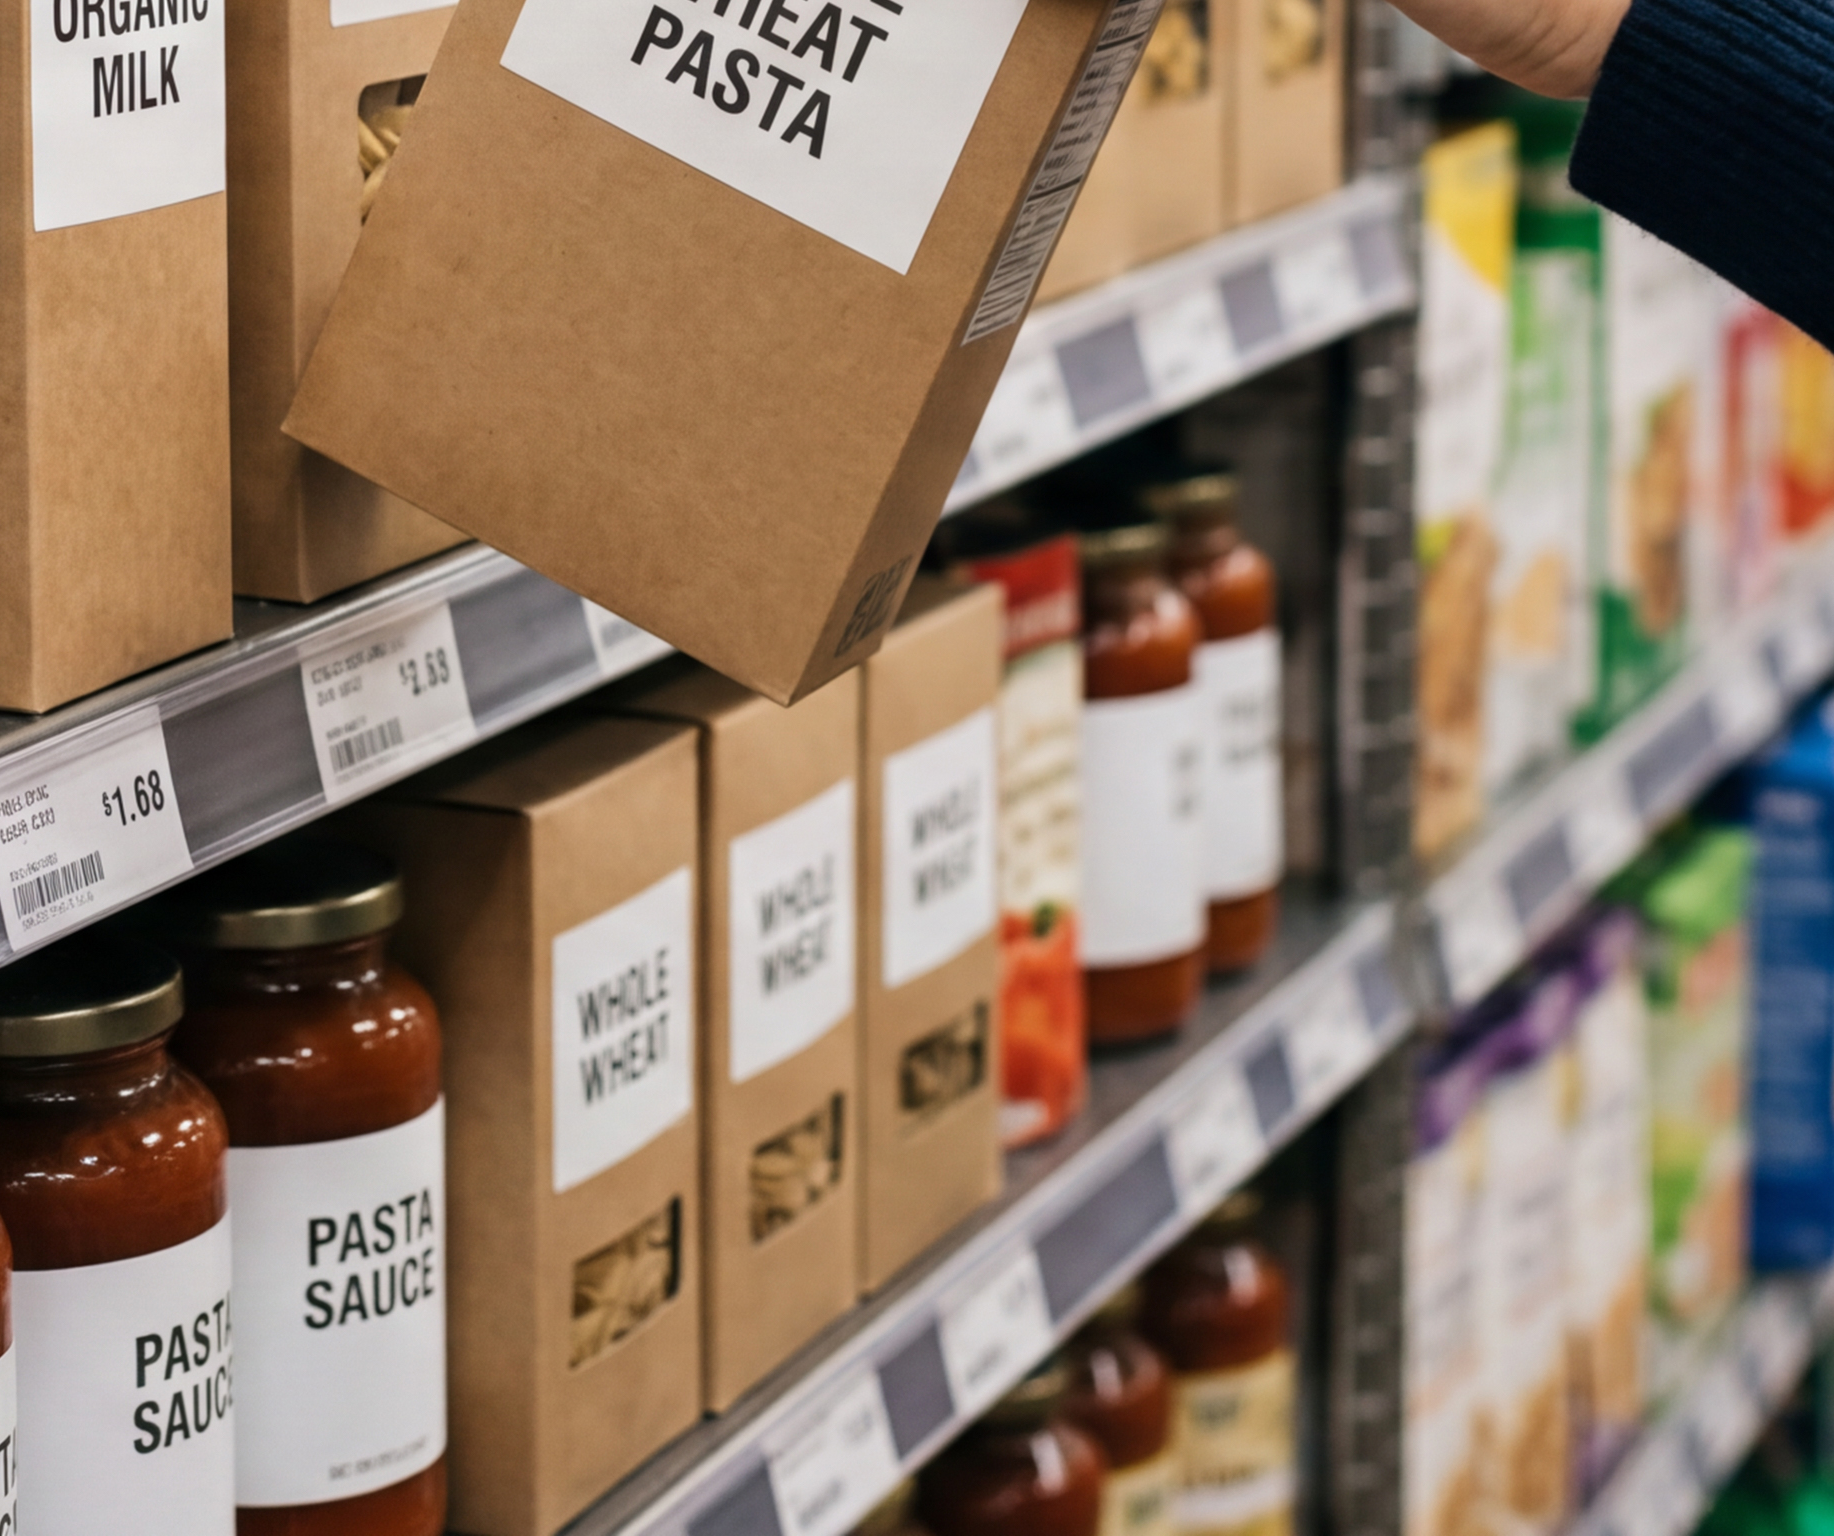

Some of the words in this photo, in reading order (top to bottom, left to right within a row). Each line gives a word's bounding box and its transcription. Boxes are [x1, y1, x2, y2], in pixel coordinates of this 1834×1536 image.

[92, 45, 180, 118] MILK
[630, 5, 831, 160] PASTA
[103, 770, 164, 826] $1.68
[578, 948, 668, 1040] WHOLE
[580, 1011, 668, 1104] WHEAT
[309, 1188, 433, 1266] PASTA
[305, 1248, 434, 1329] SAUCE
